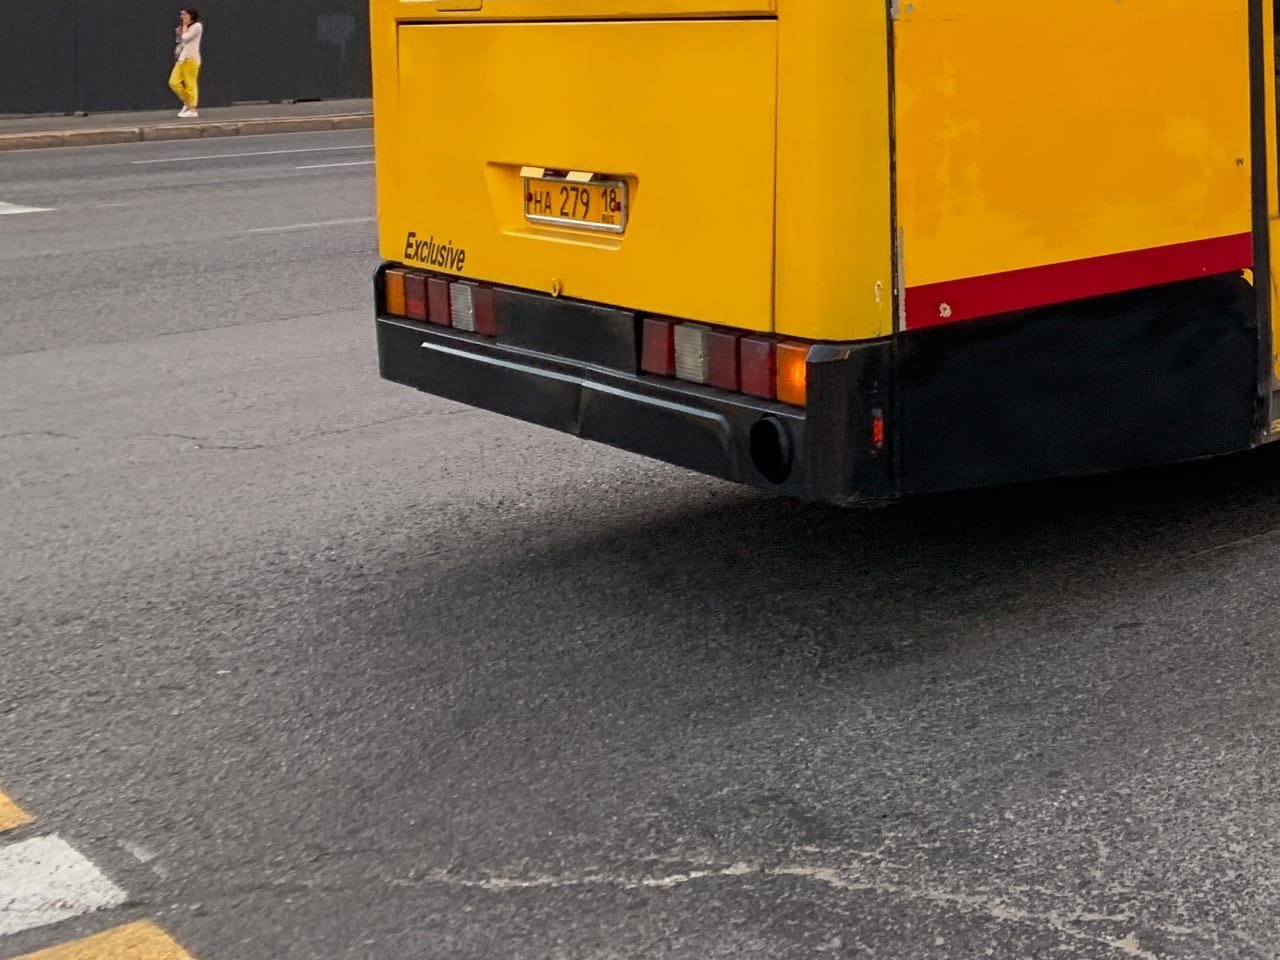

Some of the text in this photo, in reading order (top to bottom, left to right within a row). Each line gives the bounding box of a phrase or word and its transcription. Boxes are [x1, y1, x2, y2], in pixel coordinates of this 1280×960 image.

[560, 186, 590, 219] 279
[601, 187, 617, 213] 18
[404, 232, 465, 272] Exclusive
